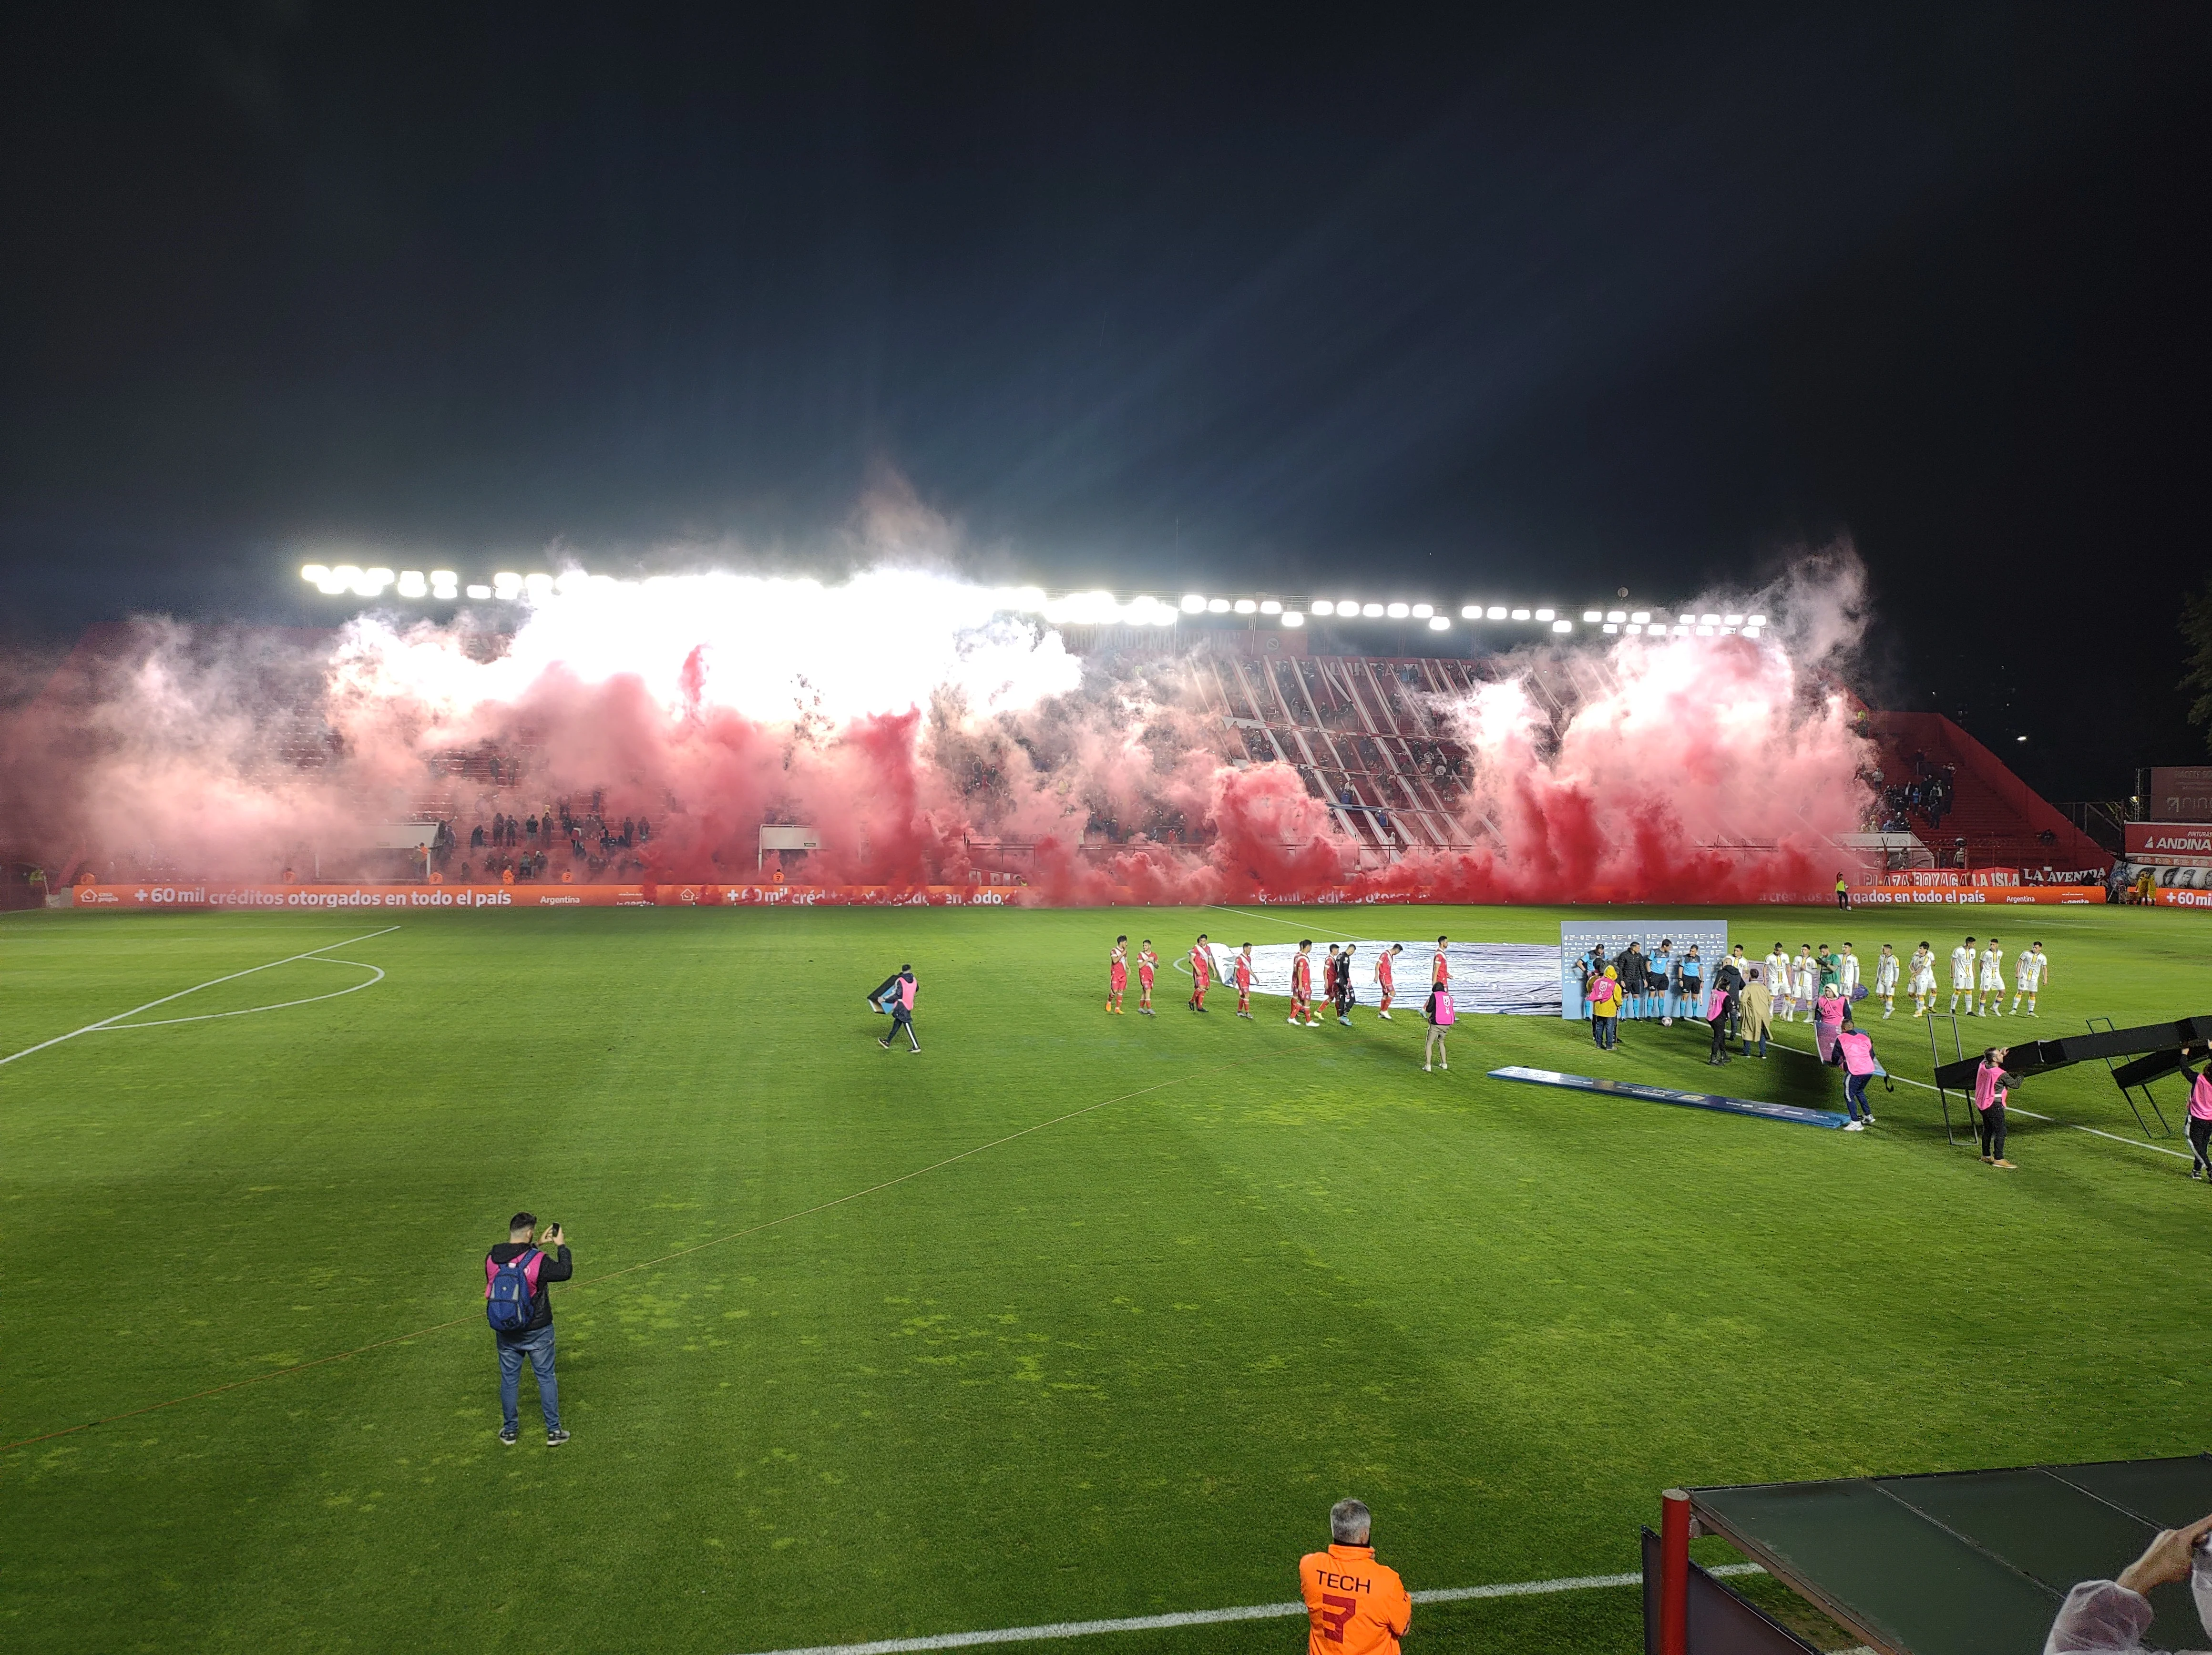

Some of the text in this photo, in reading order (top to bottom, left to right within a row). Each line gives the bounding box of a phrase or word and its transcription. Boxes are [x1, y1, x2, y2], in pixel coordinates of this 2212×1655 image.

[2156, 837, 2212, 851] ANDINA
[1990, 872, 2020, 887] ISLA
[2023, 868, 2045, 881] LA
[177, 887, 205, 902] mil
[209, 889, 284, 905] créditos
[287, 889, 380, 908] otorgados
[384, 893, 407, 905] en
[410, 889, 453, 906] todo
[456, 889, 471, 905] el
[476, 889, 512, 907] país
[540, 895, 580, 905] Argentina
[967, 889, 1002, 904] odo
[1895, 893, 1910, 903] en
[1912, 889, 1942, 903] todo
[1945, 889, 1957, 903] el
[1960, 889, 1986, 904] país
[2006, 895, 2035, 904] Argentina
[1316, 1569, 1371, 1594] TECH
